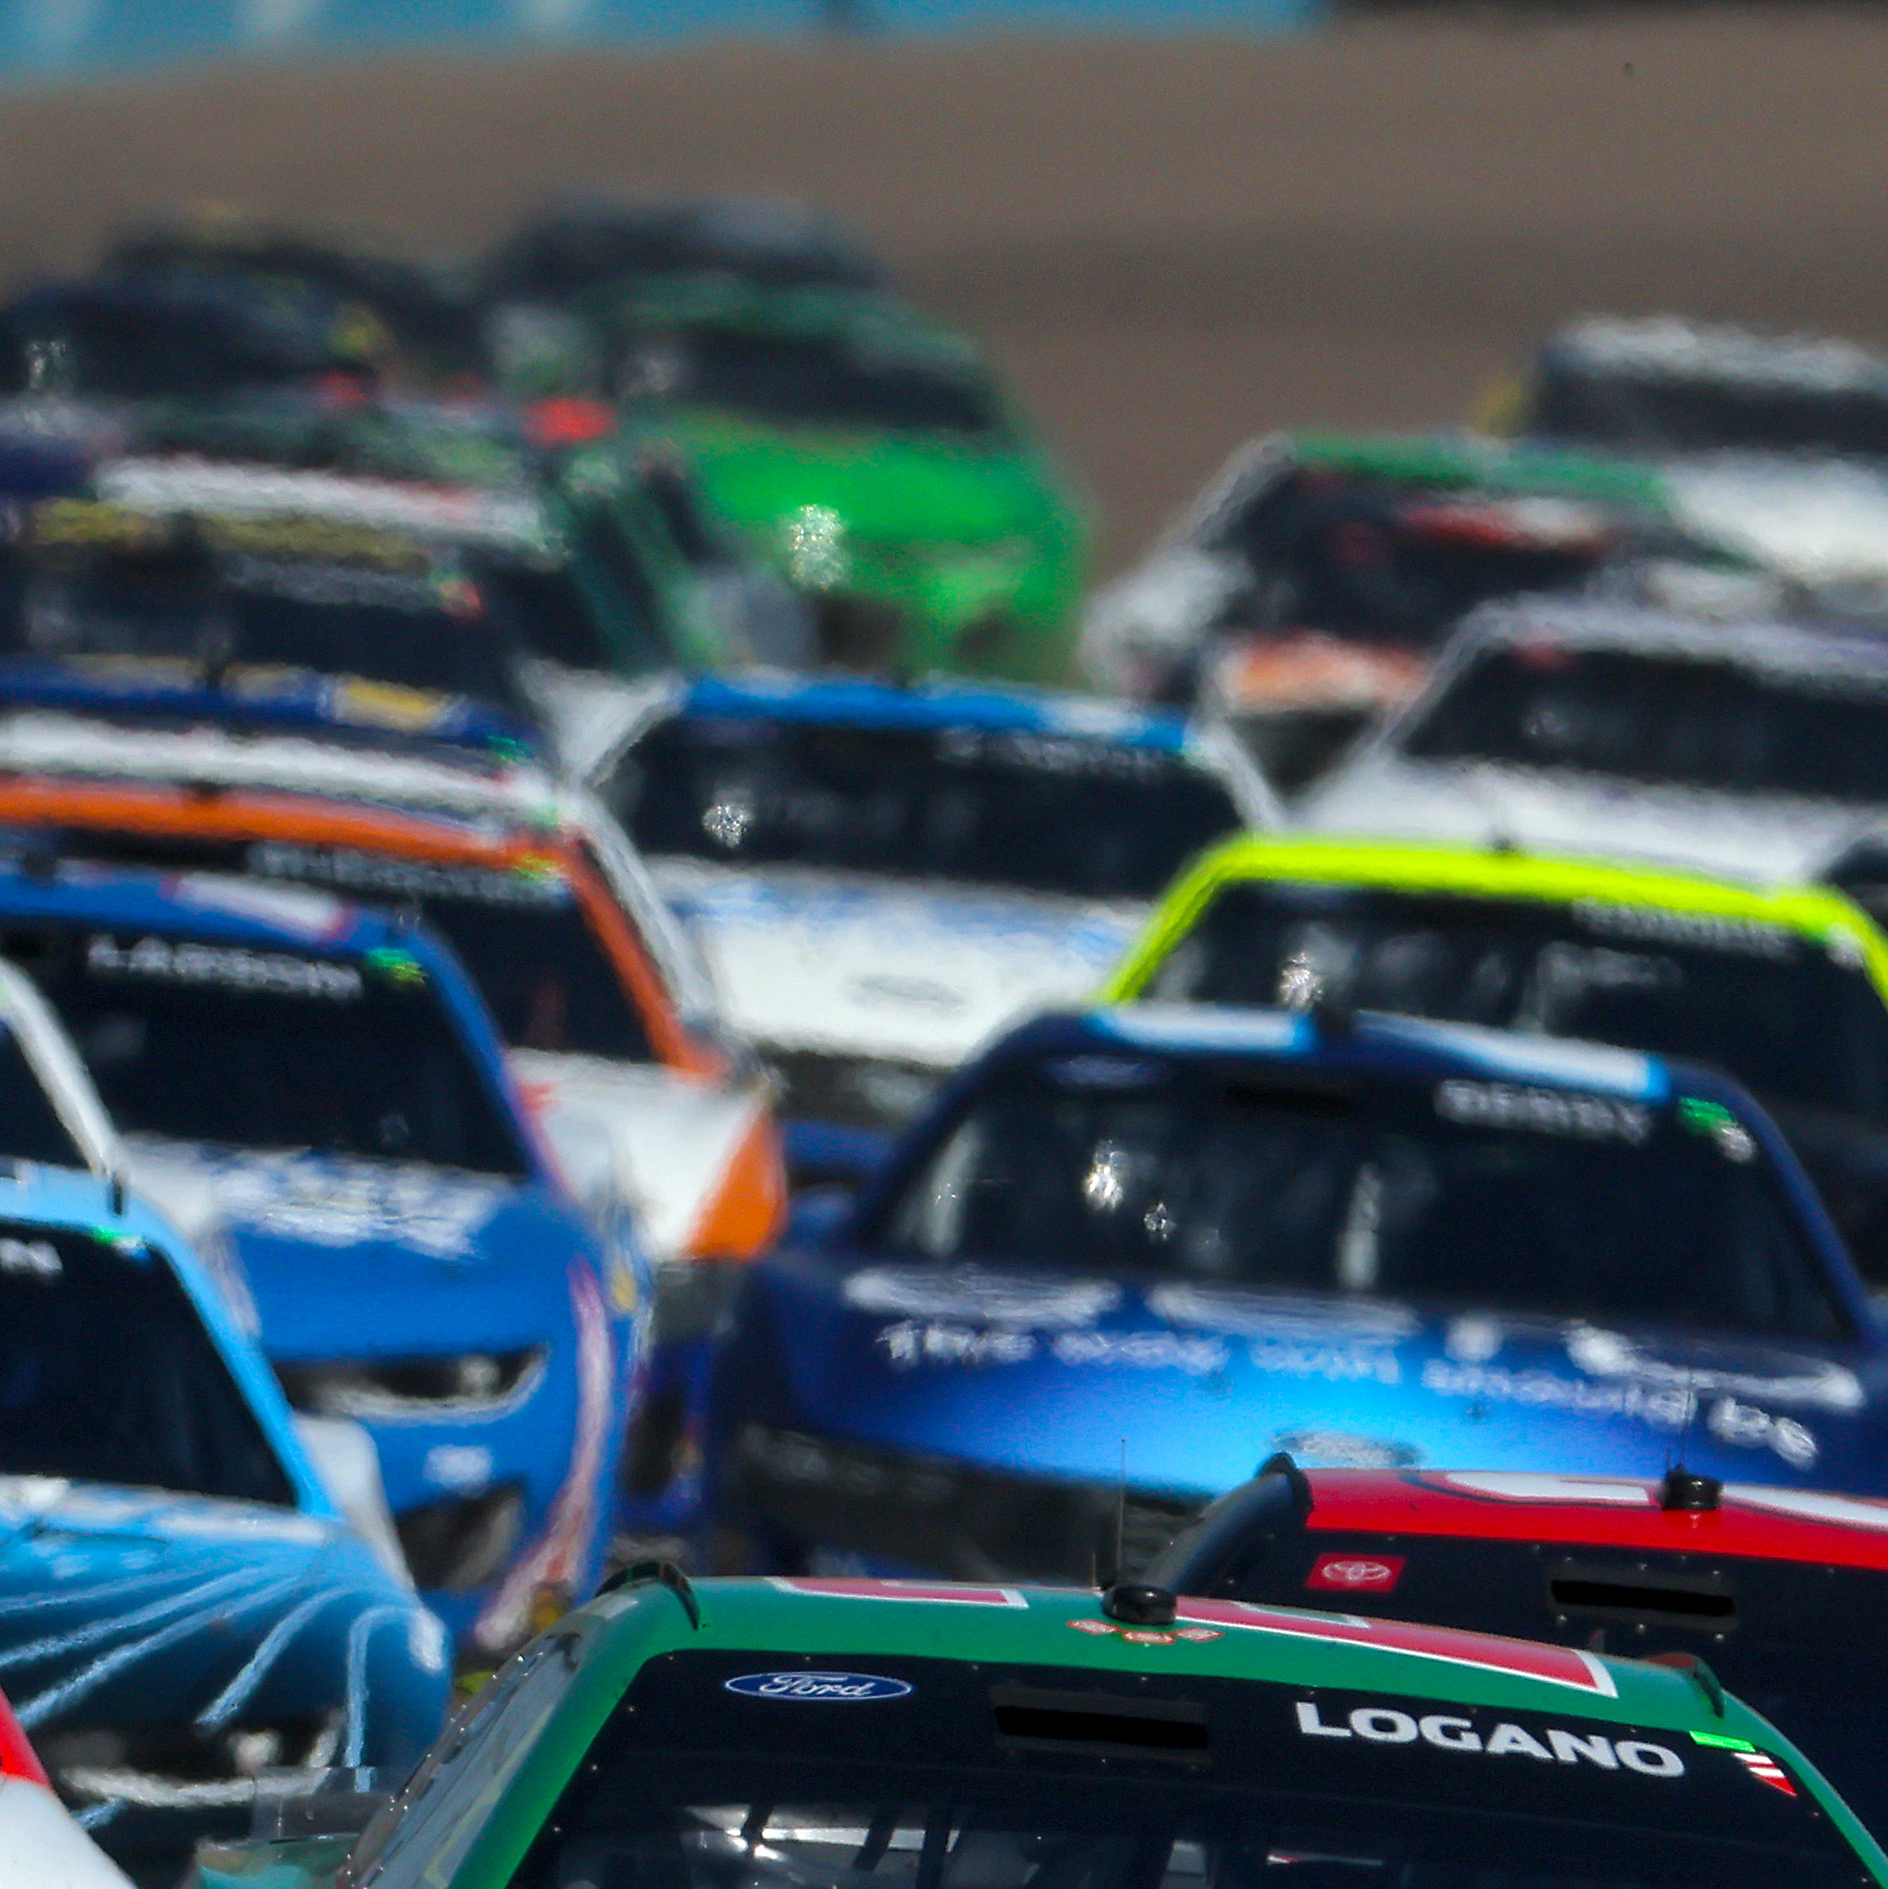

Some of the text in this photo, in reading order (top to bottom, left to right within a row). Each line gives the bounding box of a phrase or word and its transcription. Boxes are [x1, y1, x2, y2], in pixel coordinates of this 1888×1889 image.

[87, 935, 363, 1001] LARSON
[756, 1671, 878, 1702] Ford
[1294, 1701, 1687, 1778] LOGANO
